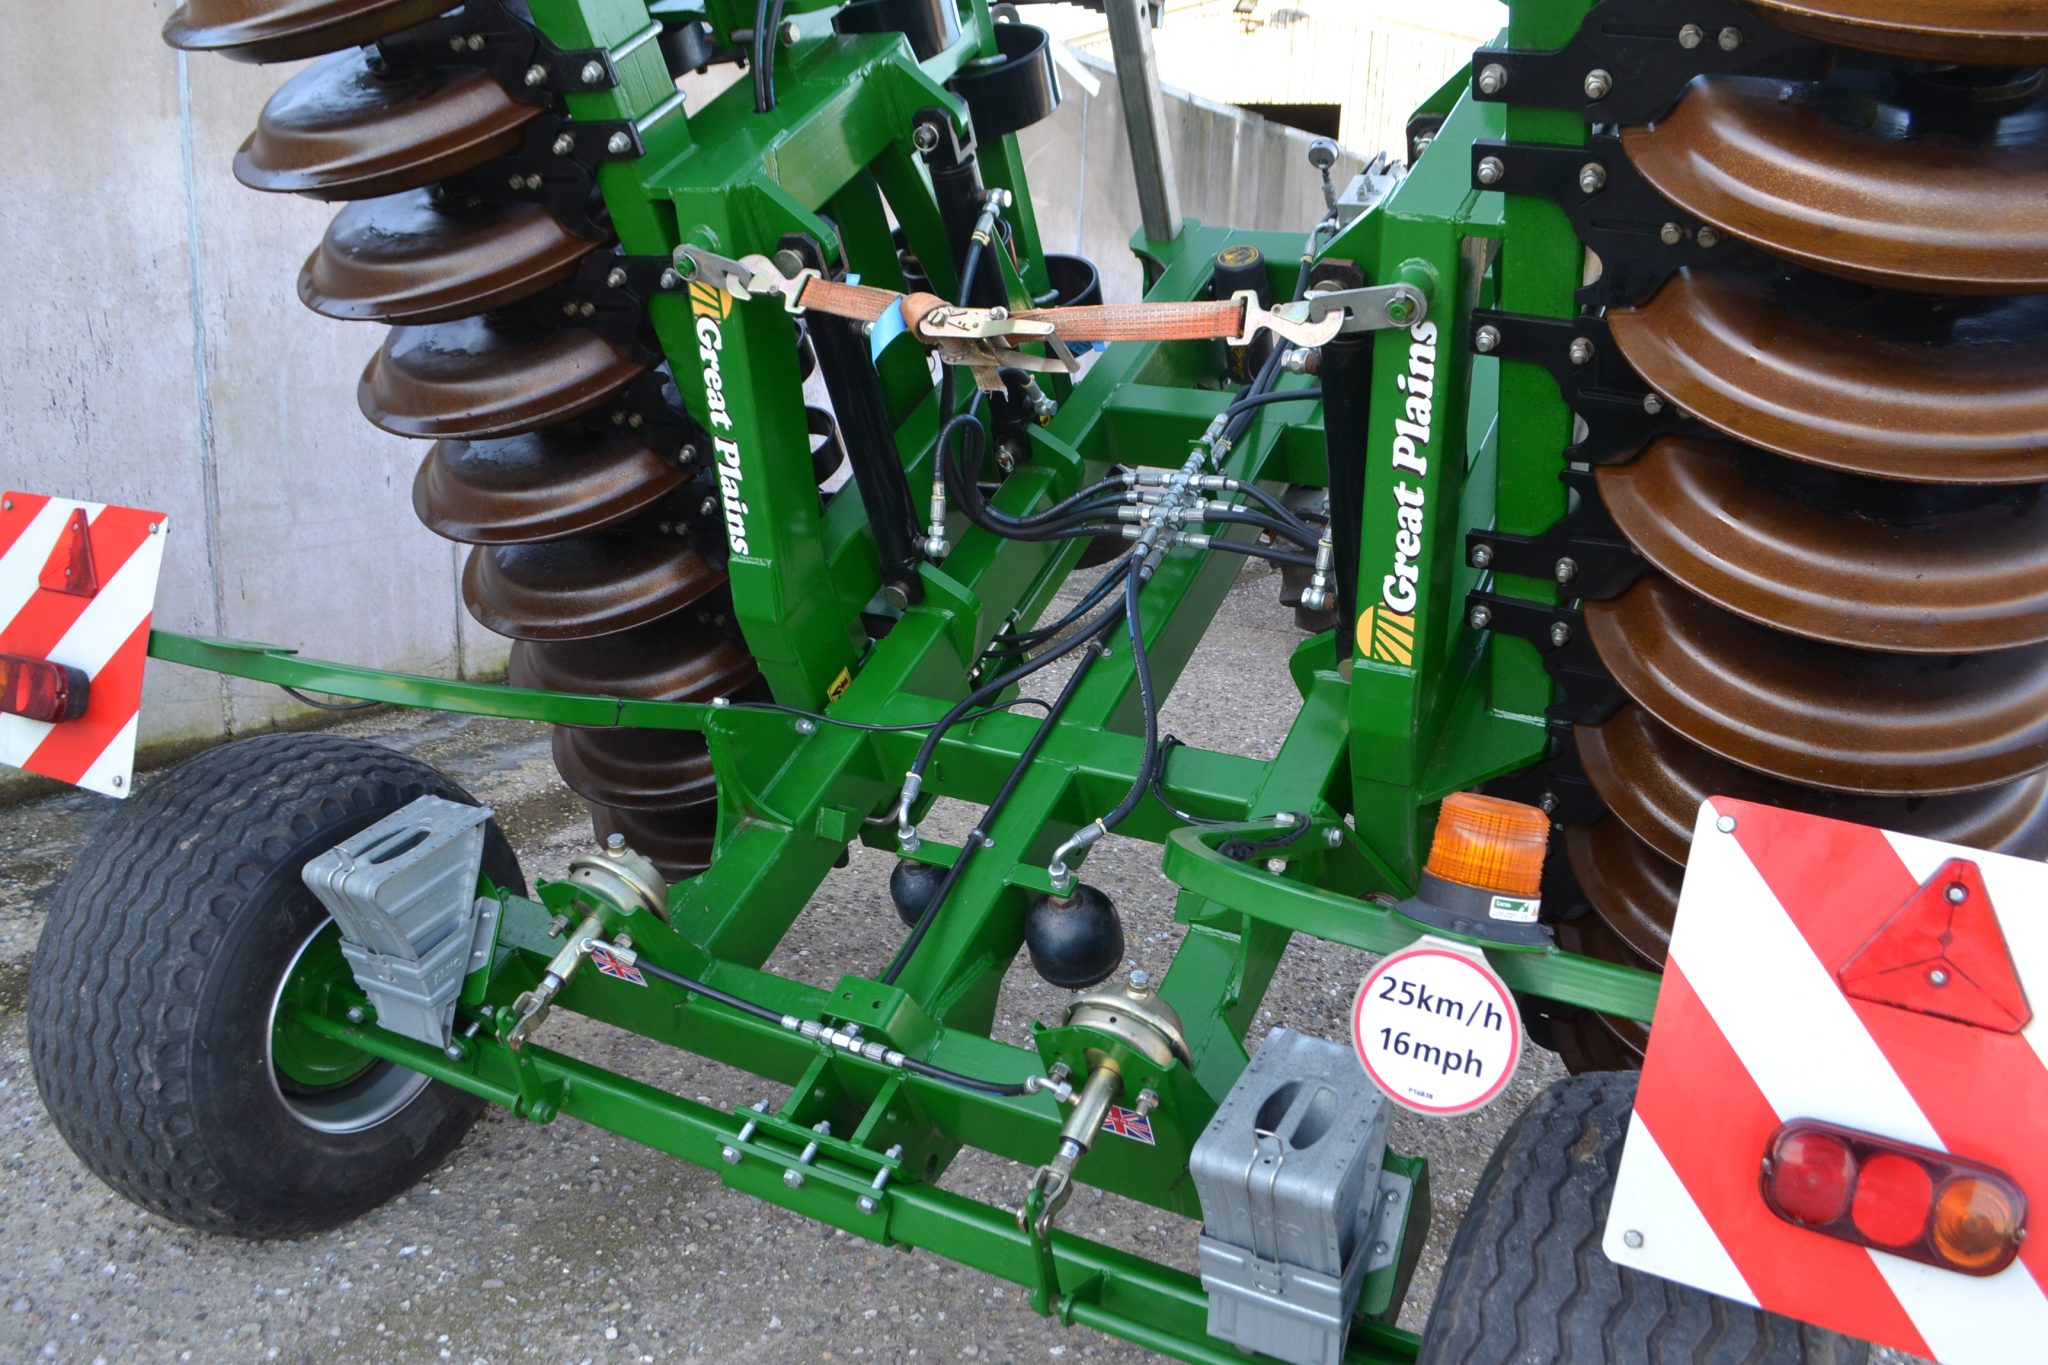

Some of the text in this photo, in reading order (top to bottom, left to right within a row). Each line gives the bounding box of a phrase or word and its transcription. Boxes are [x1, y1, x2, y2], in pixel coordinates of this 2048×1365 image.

[696, 314, 750, 556] Great Plains
[1382, 321, 1438, 615] Great Plains
[1378, 975, 1503, 1031] 25km/h
[1380, 1027, 1483, 1078] 16mph
